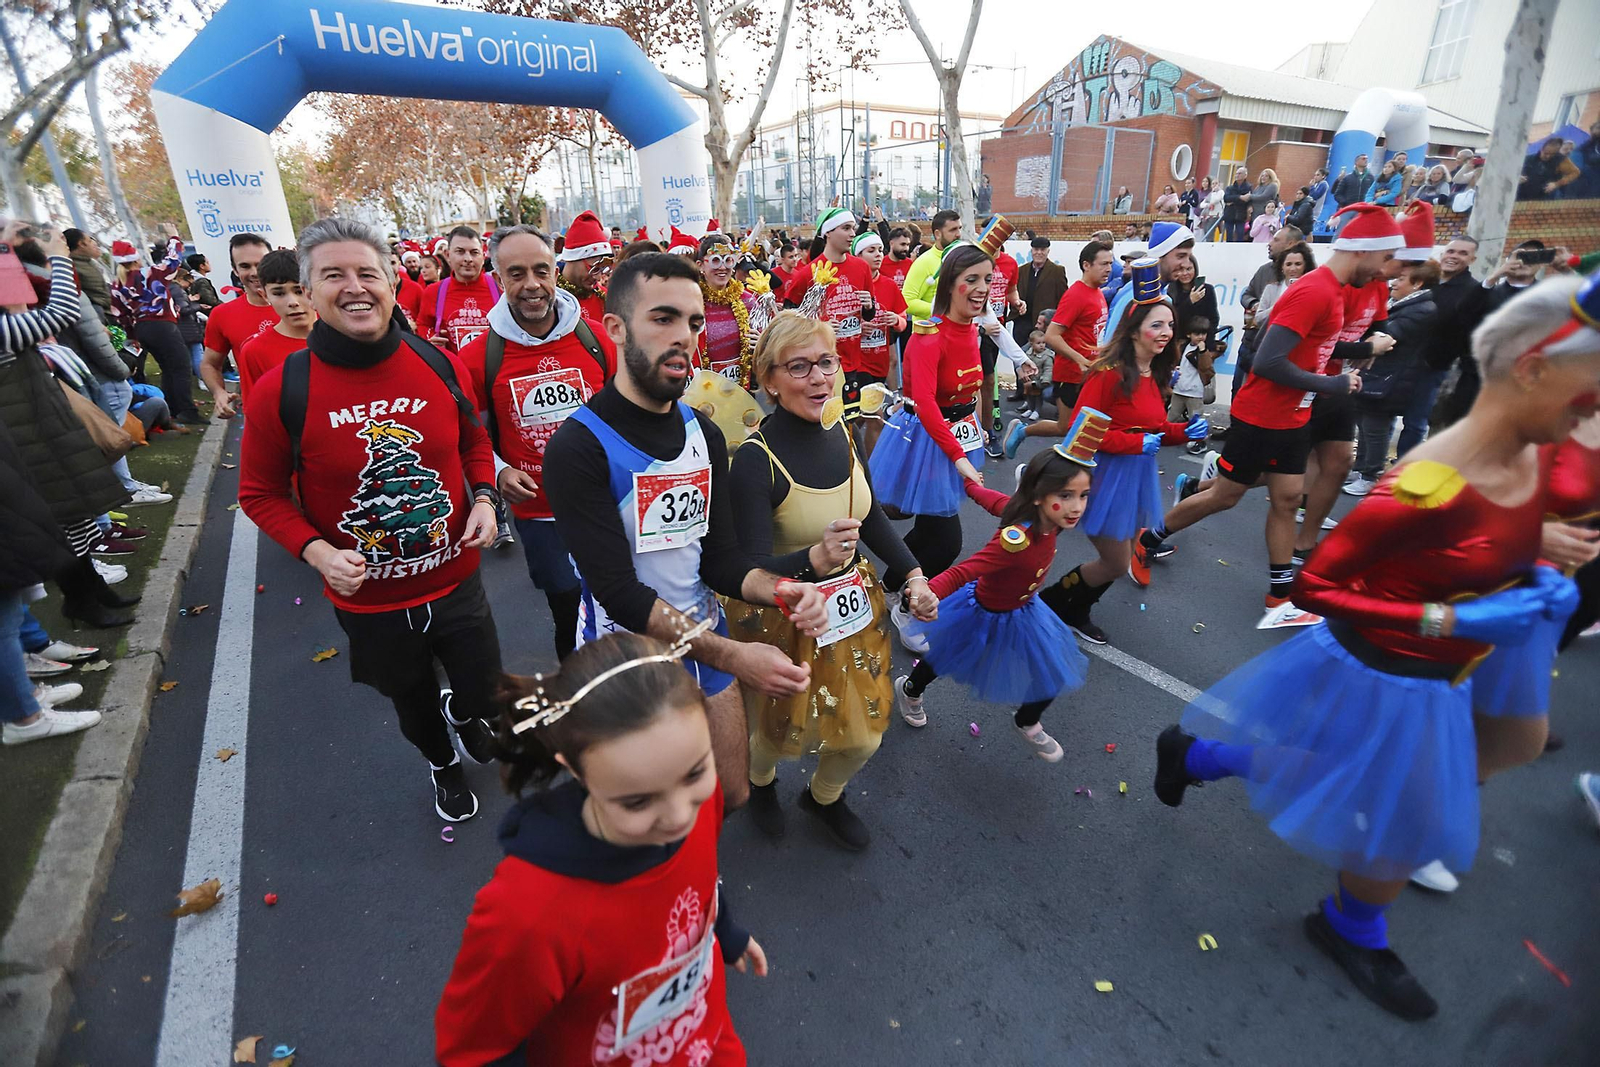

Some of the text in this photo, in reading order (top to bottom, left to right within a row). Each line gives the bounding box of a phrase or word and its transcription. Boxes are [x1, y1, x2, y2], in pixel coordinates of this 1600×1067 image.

[309, 8, 598, 77] Huelva original
[186, 169, 261, 187] Huelva
[662, 174, 706, 189] Huelva
[227, 224, 272, 233] HUELVA
[842, 318, 857, 329] 245
[722, 366, 740, 379] 146
[533, 384, 569, 408] 488
[329, 397, 428, 428] MERRY
[955, 424, 970, 440] 49
[520, 461, 543, 472] Hue
[661, 489, 698, 523] 325
[365, 542, 462, 580] RISTMAS
[836, 589, 859, 618] 86
